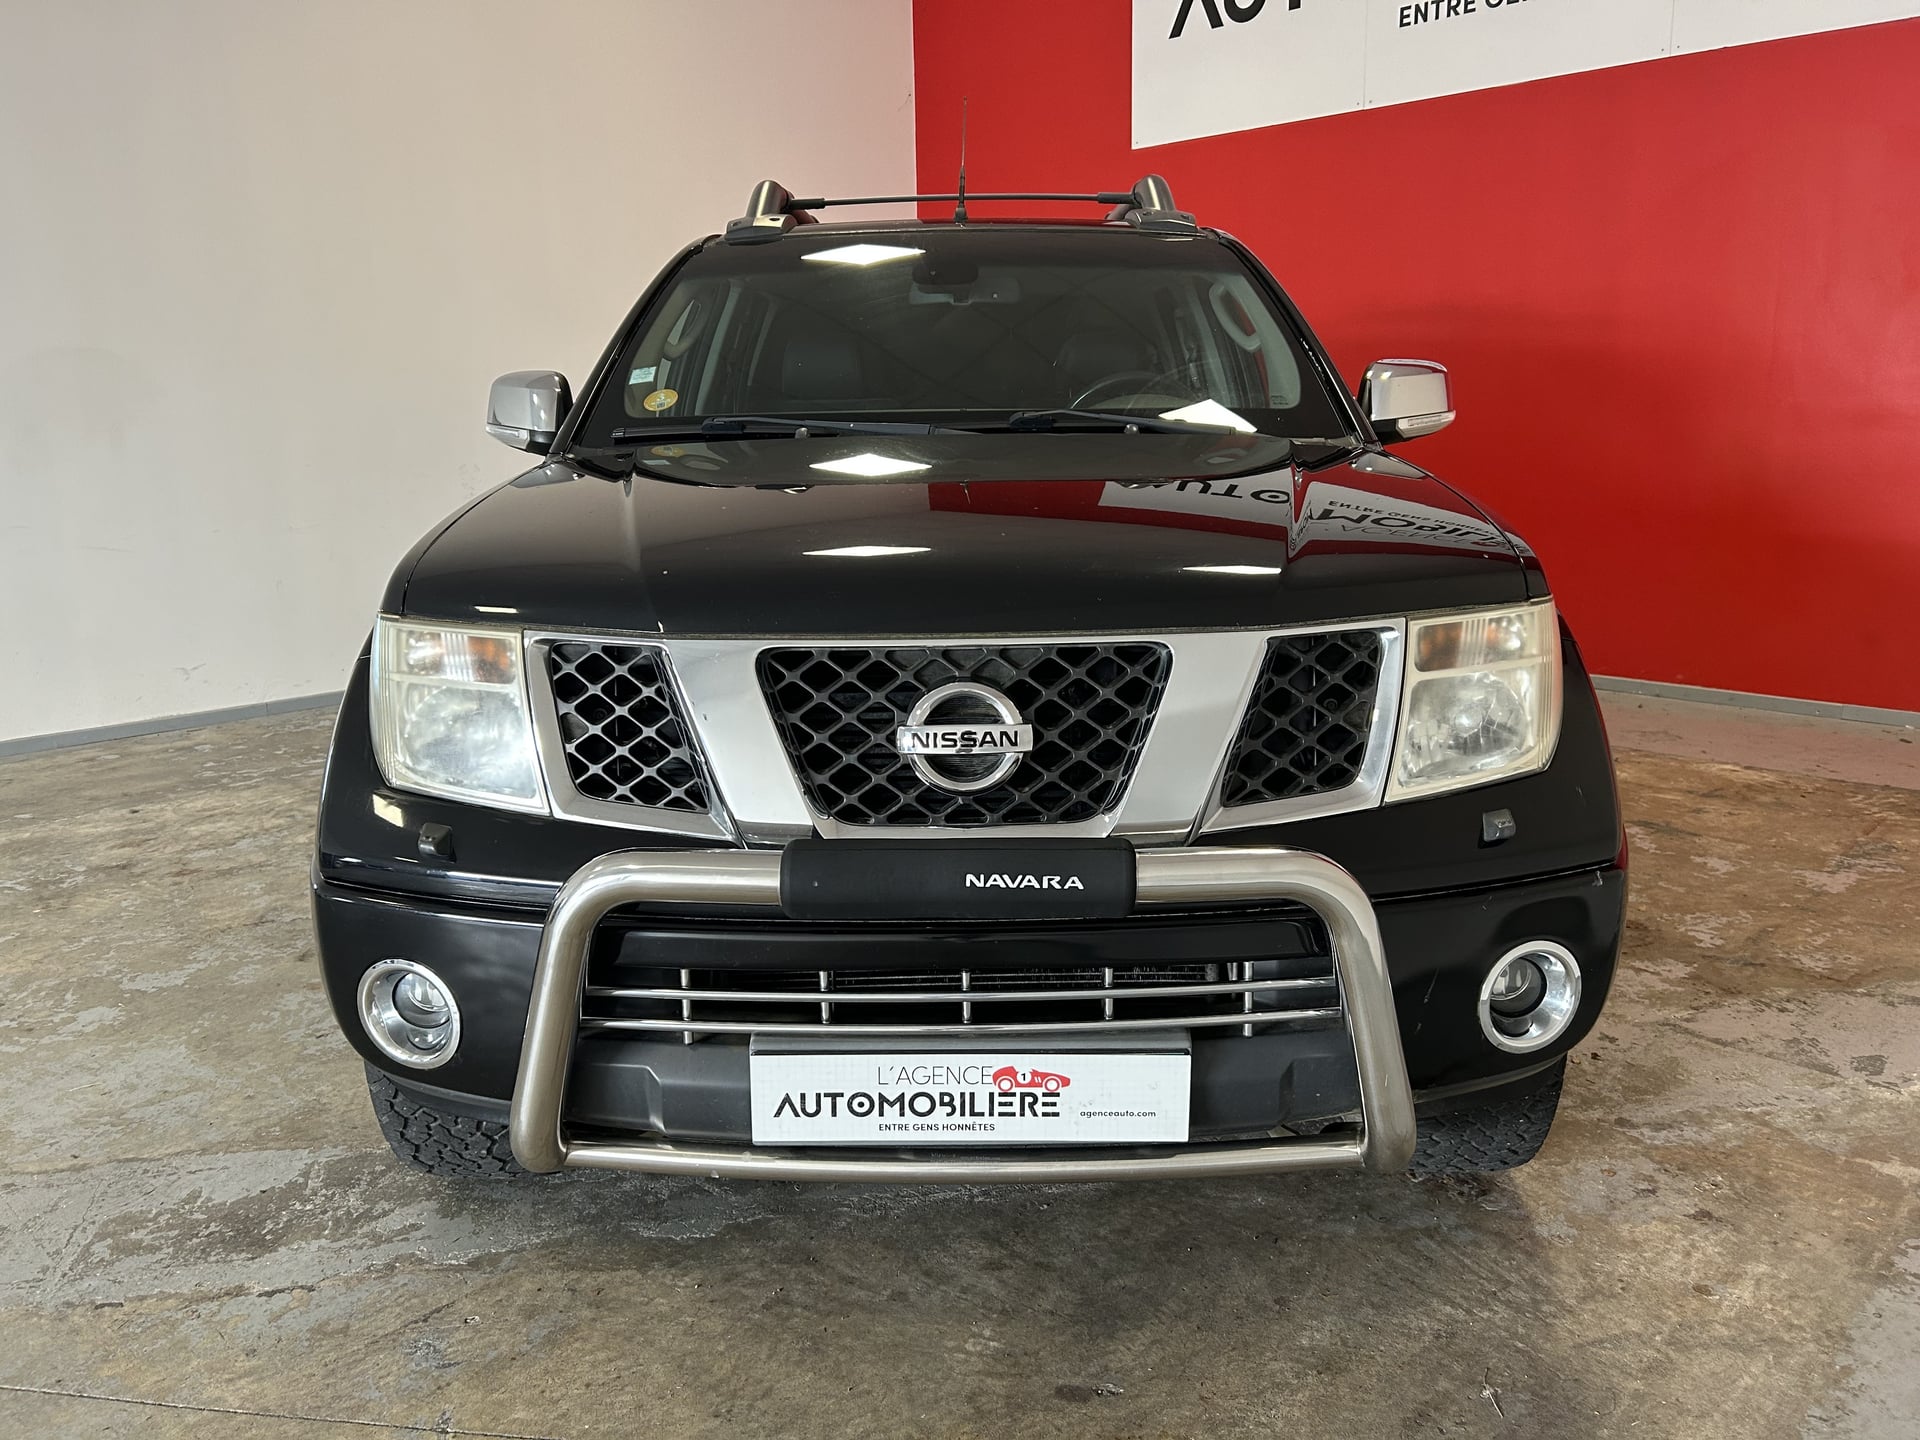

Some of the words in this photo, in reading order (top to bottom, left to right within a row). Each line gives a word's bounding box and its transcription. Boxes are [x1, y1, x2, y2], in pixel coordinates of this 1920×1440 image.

[1399, 0, 1476, 28] ENTRE
[912, 730, 1019, 749] NISSAN
[965, 873, 1084, 890] NAVARA
[878, 1065, 992, 1086] L'AGENCE
[1080, 1109, 1157, 1119] agenceauto.com
[879, 1123, 910, 1132] ENTRE
[912, 1123, 940, 1132] GENS
[942, 1121, 995, 1132] HONNÊTES
